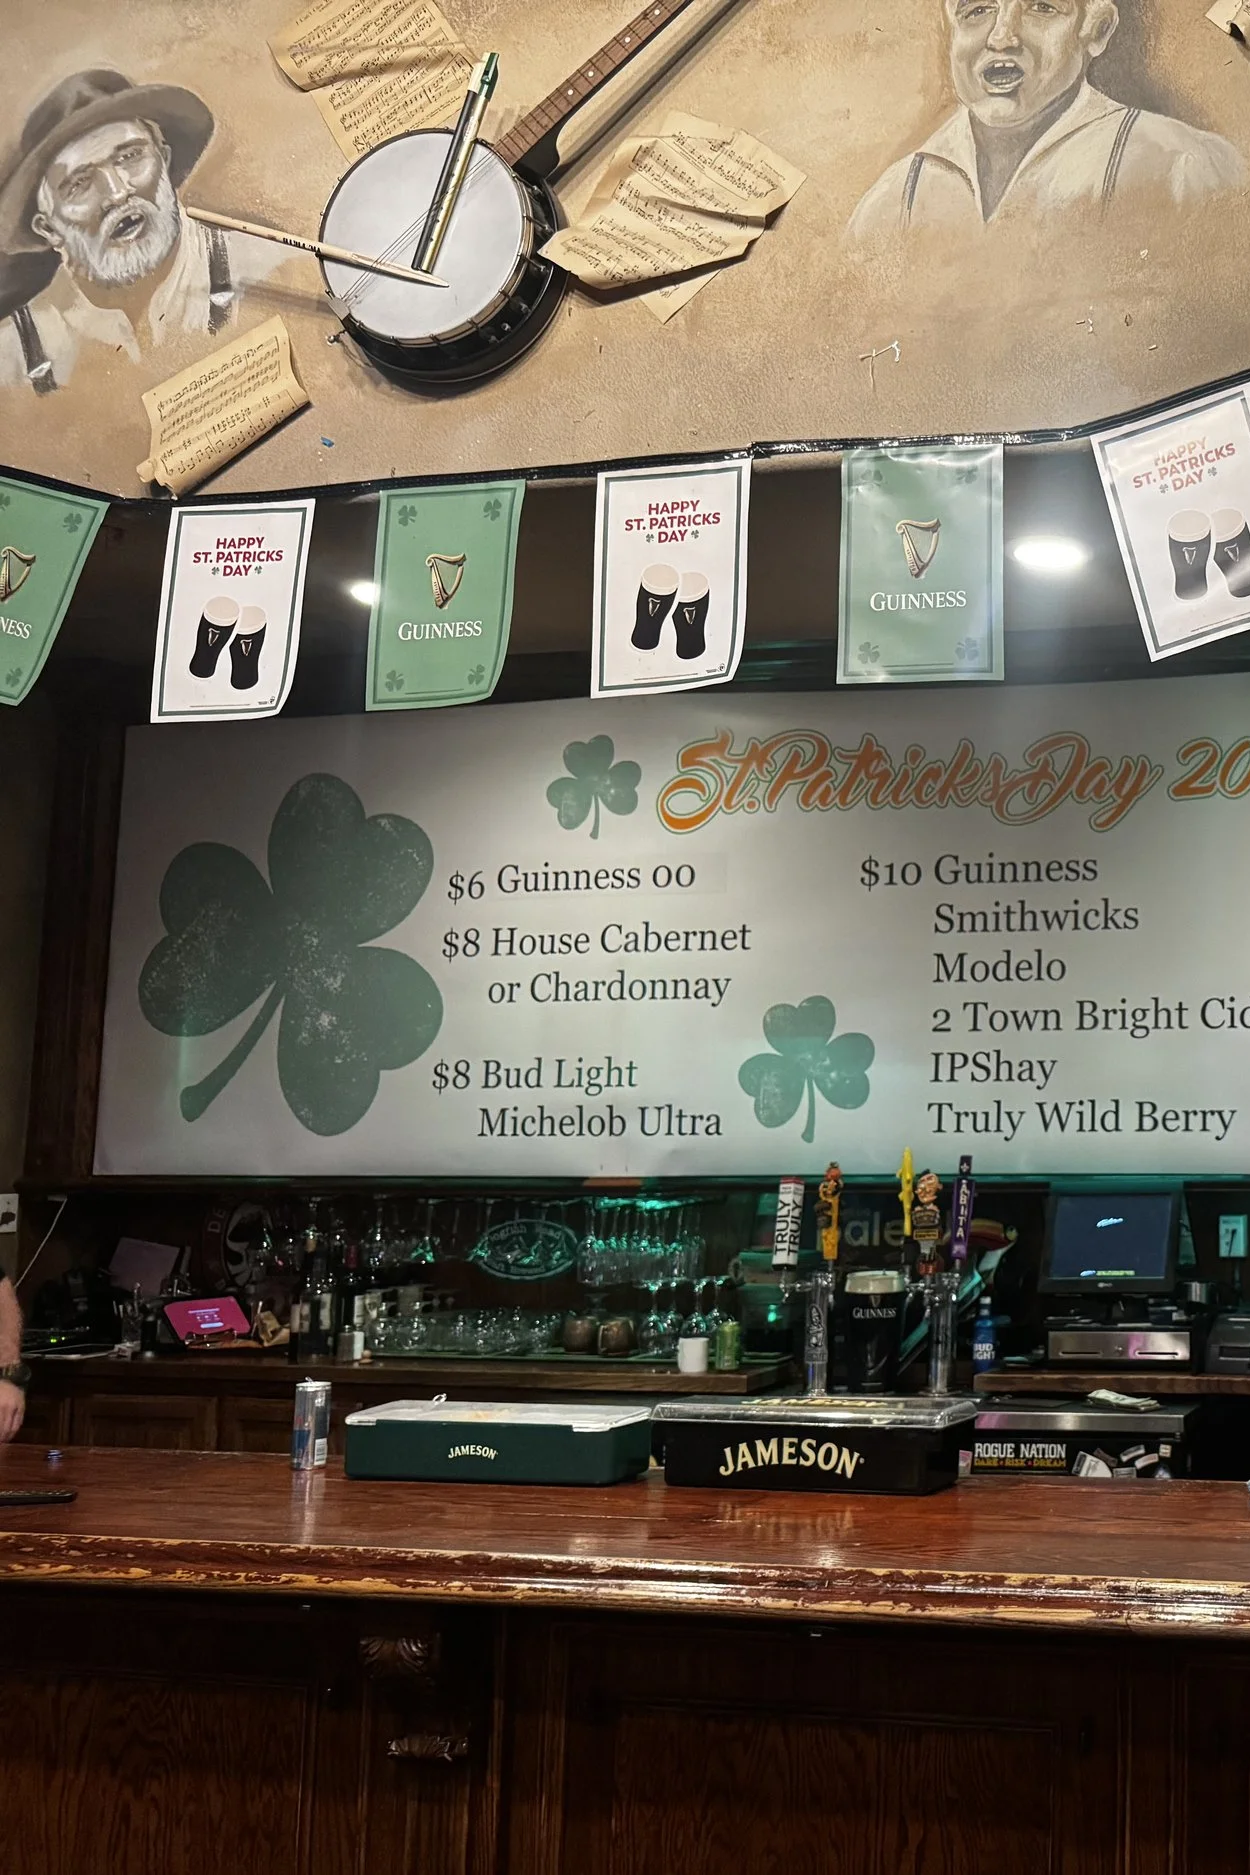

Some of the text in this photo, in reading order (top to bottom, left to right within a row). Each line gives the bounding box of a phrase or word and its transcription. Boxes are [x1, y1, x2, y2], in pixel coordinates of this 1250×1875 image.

[1133, 443, 1236, 489] ST. PATRICKS
[1154, 436, 1208, 467] HAPPY
[1172, 469, 1204, 492] DAY
[625, 512, 721, 531] ST. PATRICKS
[648, 500, 700, 515] HAPPY
[216, 536, 265, 549] HAPPY
[657, 529, 688, 544] DAY
[193, 550, 283, 563] ST. PATRICKS
[223, 565, 252, 577] DAY
[869, 590, 967, 612] GUINNESS
[0, 616, 32, 639] NESS
[398, 620, 483, 641] GUINNESS
[447, 870, 485, 905] $6
[496, 862, 641, 894] Guinness
[859, 852, 1099, 892] $10 Guinness
[933, 898, 1140, 934] Smithwicks
[442, 921, 752, 963] $8 House Cabernet
[932, 949, 1067, 984] Modelo
[488, 969, 732, 1008] or Chardonnay
[931, 1007, 952, 1033] 2
[963, 1001, 1063, 1033] Town
[1075, 997, 1189, 1039] Bright
[432, 1055, 638, 1096] $8 Bud Light
[929, 1049, 1058, 1090] IPShay
[477, 1104, 722, 1138] Michelob Ultra
[927, 1099, 1237, 1142] Truly Wild Berry
[775, 1199, 791, 1255] TRULY
[788, 1200, 802, 1256] TRULY
[852, 1307, 897, 1319] GUINNESS
[448, 1444, 497, 1460] JAMESON
[720, 1437, 860, 1479] JAMESON
[974, 1443, 1067, 1459] ROGUE NATION
